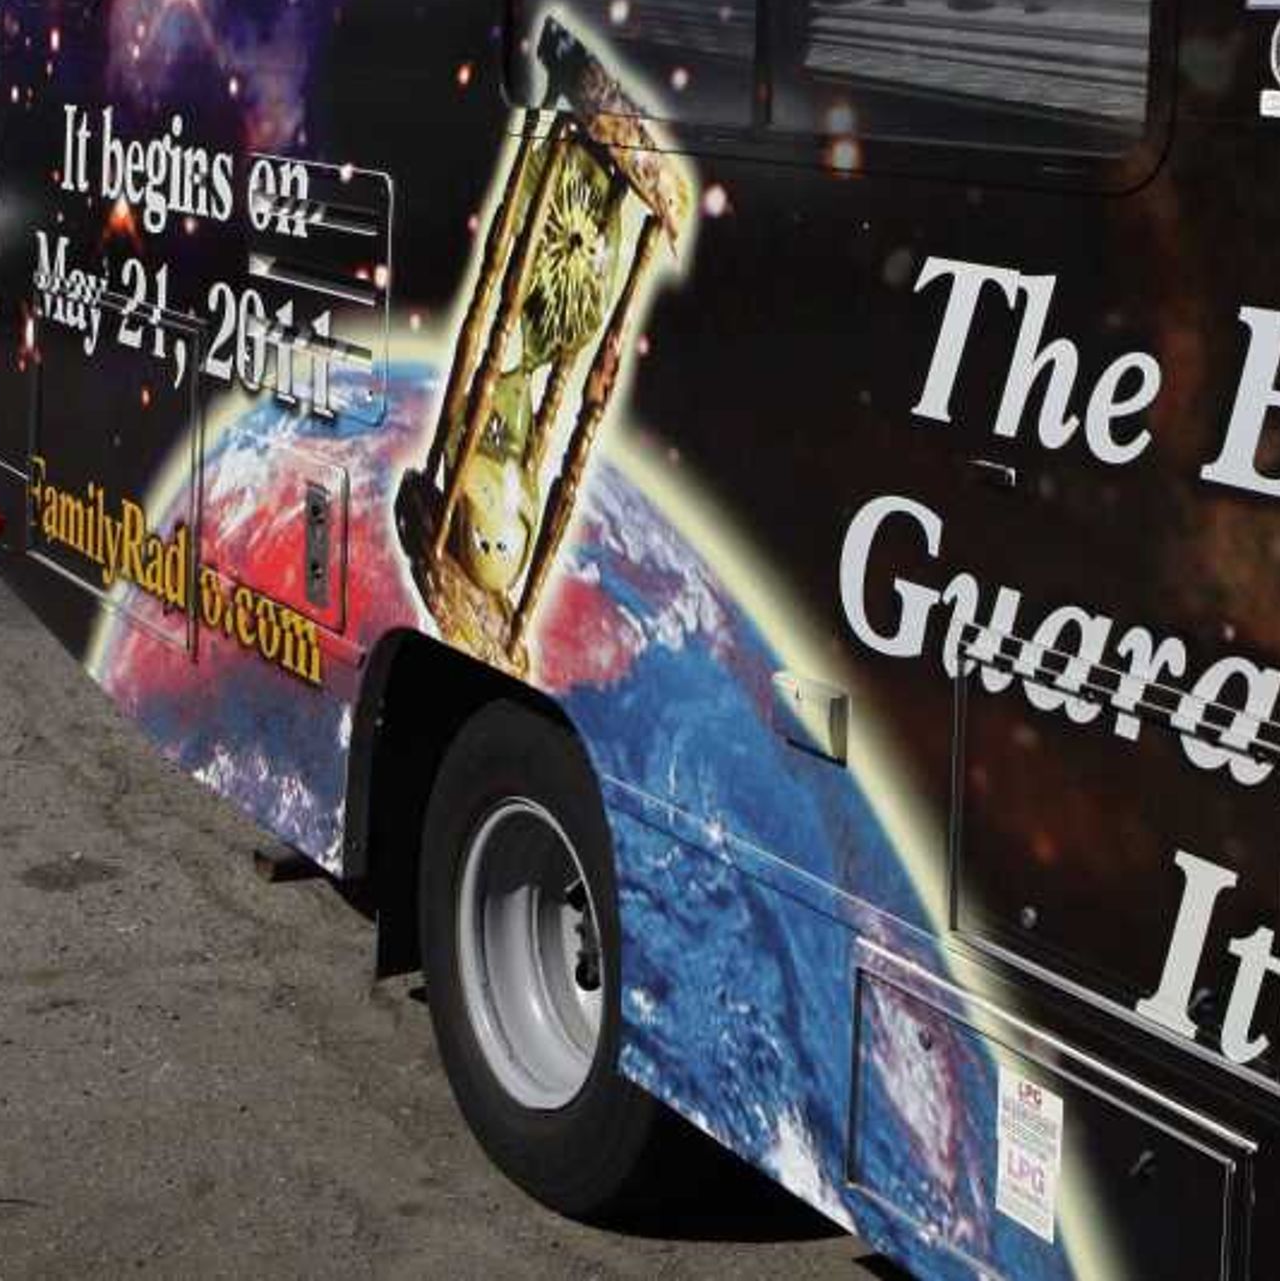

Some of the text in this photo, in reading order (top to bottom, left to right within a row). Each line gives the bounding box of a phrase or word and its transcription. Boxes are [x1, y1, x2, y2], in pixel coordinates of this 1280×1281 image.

[61, 105, 309, 238] It begins on
[34, 231, 108, 356] May
[118, 258, 185, 389] 21,
[205, 282, 333, 418] 2011
[912, 255, 1162, 466] The
[28, 455, 322, 682] FamilyRado.com
[1007, 1148, 1044, 1197] LPG
[1019, 1081, 1042, 1105] LPG
